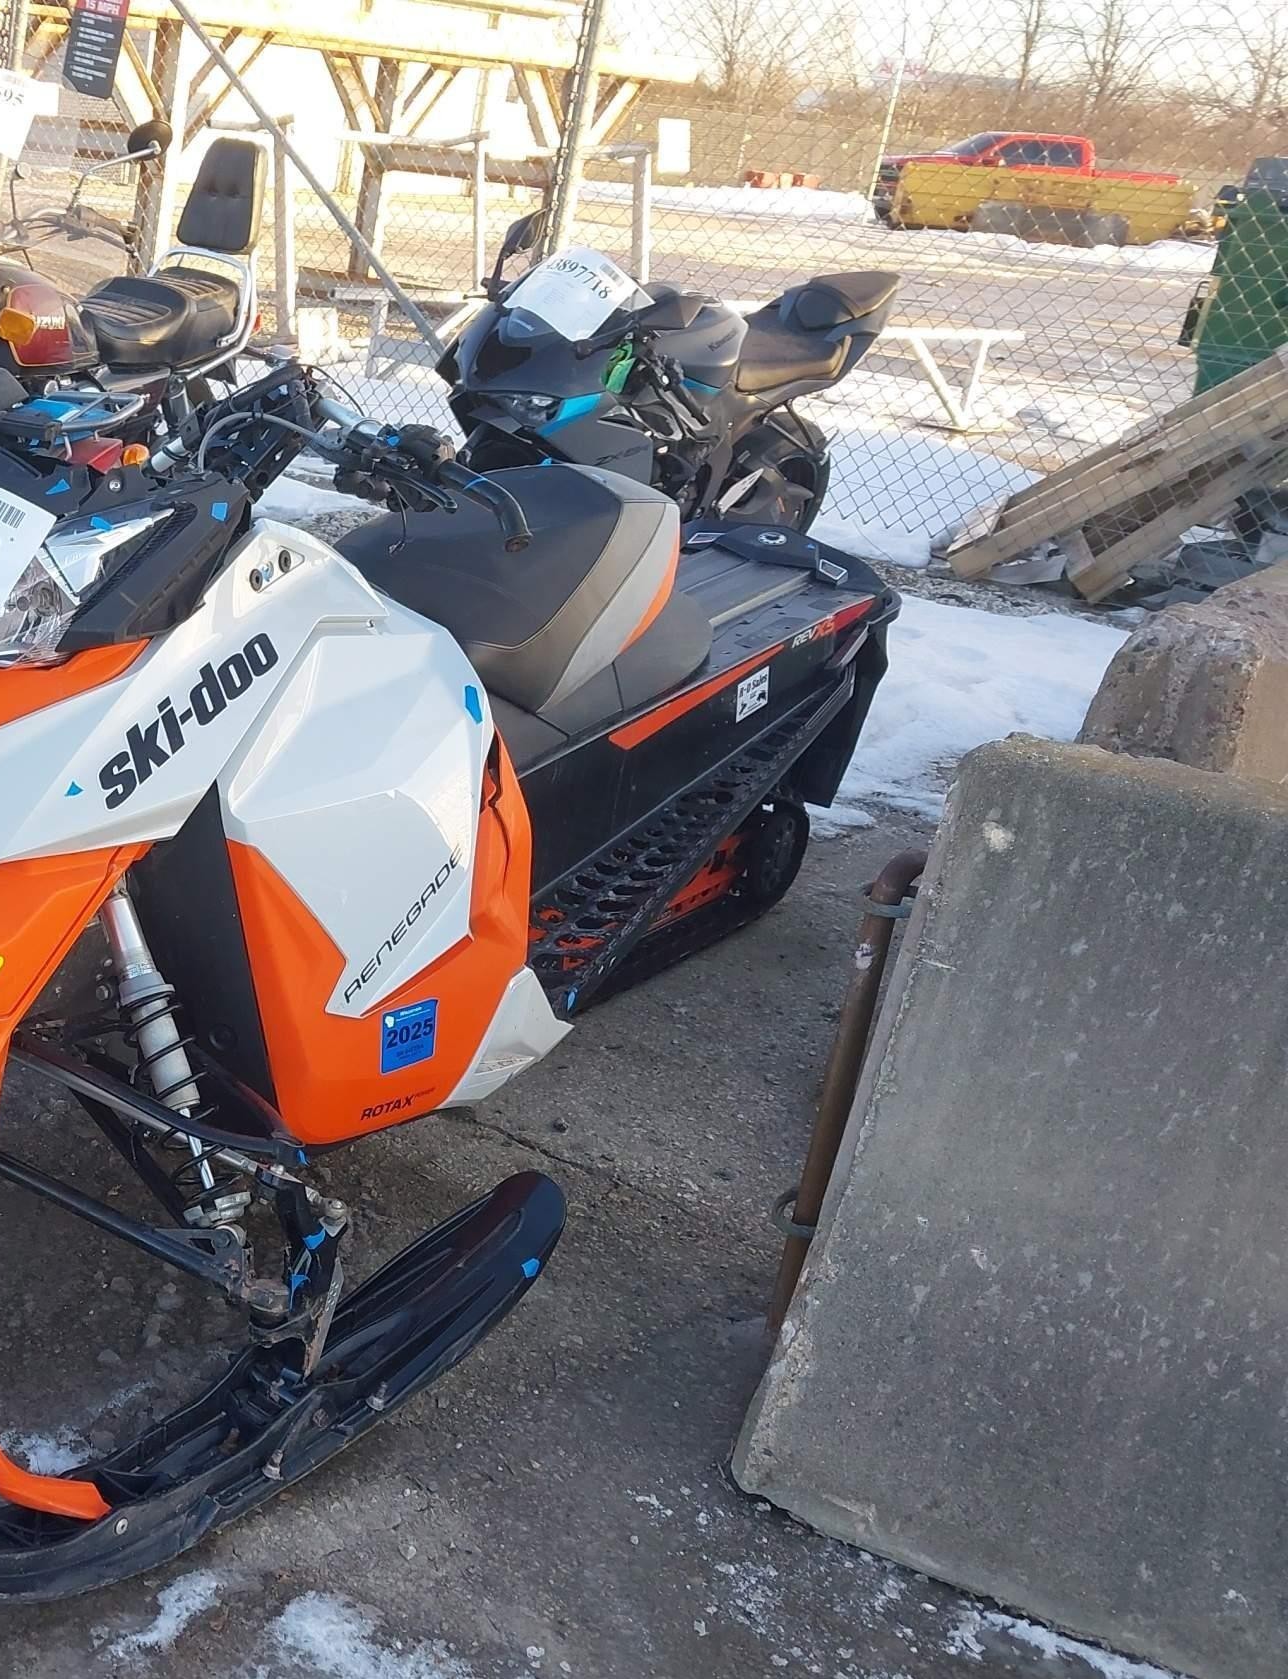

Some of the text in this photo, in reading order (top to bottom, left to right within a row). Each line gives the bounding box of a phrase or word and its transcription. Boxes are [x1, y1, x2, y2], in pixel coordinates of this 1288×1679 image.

[98, 632, 279, 810] ski-doo
[343, 843, 463, 1004] RENEGADE
[385, 1016, 434, 1049] 2025
[360, 1094, 415, 1121] ROTAX
